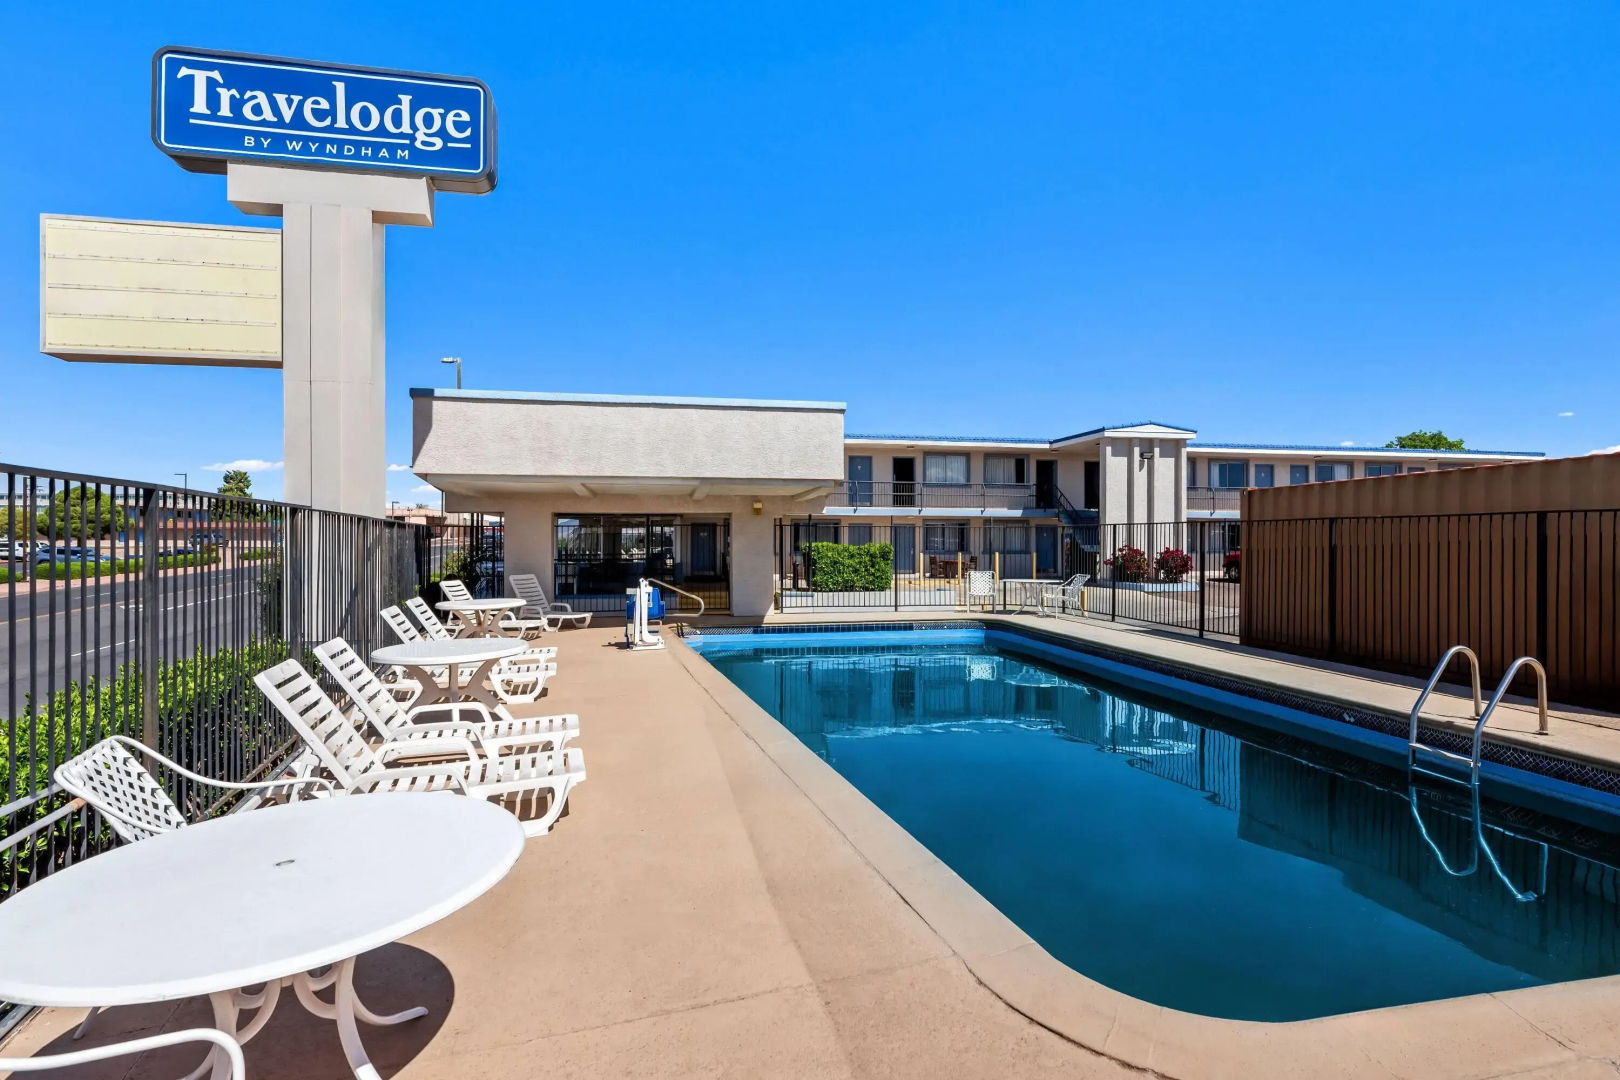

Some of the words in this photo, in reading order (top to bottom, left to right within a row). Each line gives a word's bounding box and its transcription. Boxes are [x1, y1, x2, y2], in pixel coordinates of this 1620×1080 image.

[177, 66, 472, 151] Travelodge
[244, 136, 272, 148] BY
[286, 140, 409, 160] WYNDHAM
